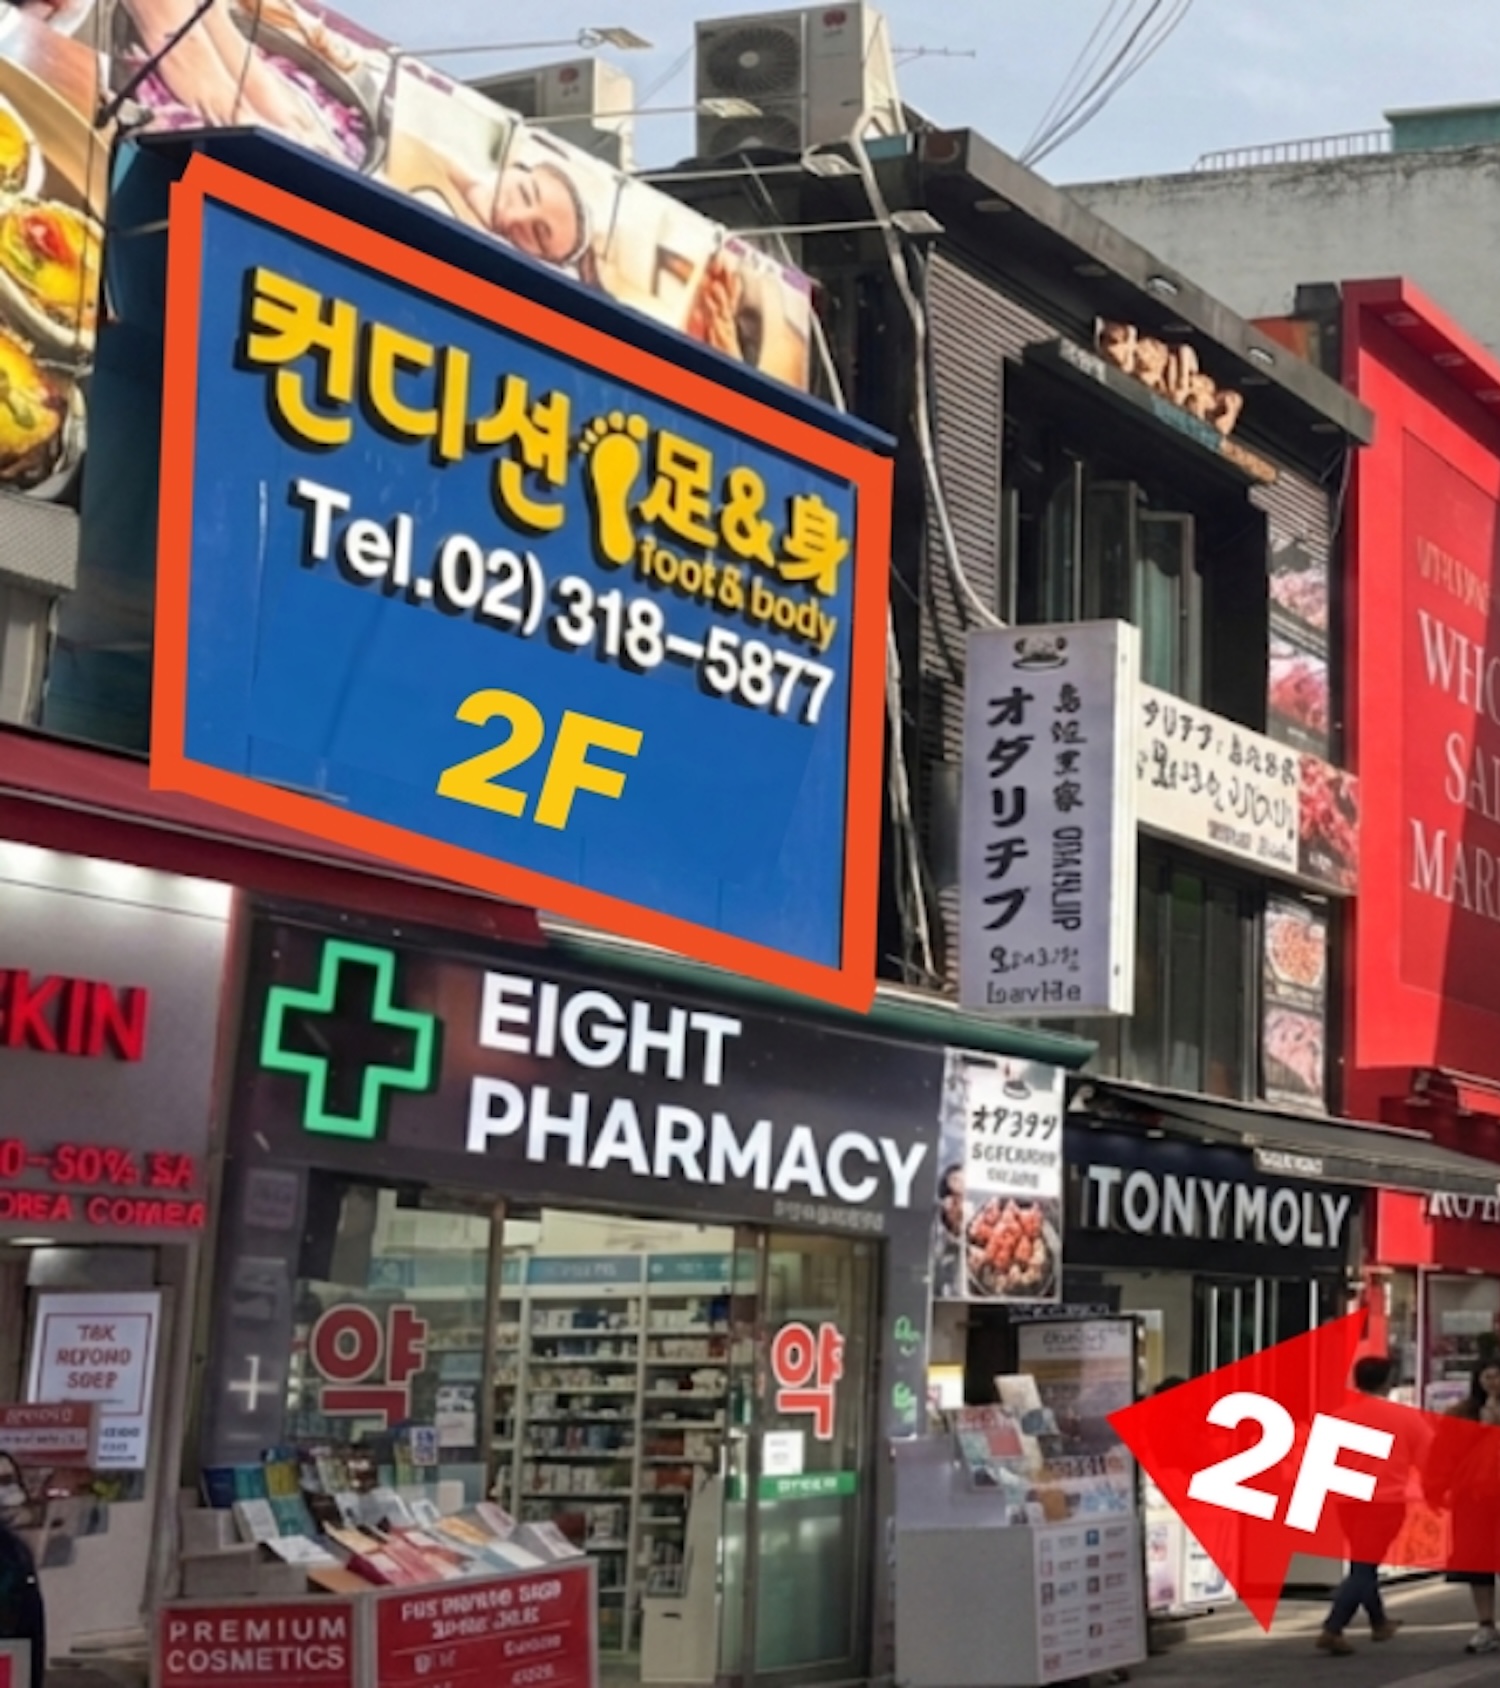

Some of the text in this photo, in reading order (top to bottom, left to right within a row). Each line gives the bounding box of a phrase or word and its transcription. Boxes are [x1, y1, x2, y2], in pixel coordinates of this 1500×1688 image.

[247, 266, 570, 530] 컨디션
[750, 575, 838, 651] body
[0, 968, 147, 1062] KIN
[479, 971, 741, 1086] EIGHT
[465, 1075, 927, 1207] PHARMACY
[1089, 1165, 1350, 1248] TONYMOLY
[310, 1303, 426, 1427] 약
[771, 1322, 845, 1440] 약
[166, 1644, 346, 1673] COSMETICS
[169, 1616, 346, 1643] PREMIUM
